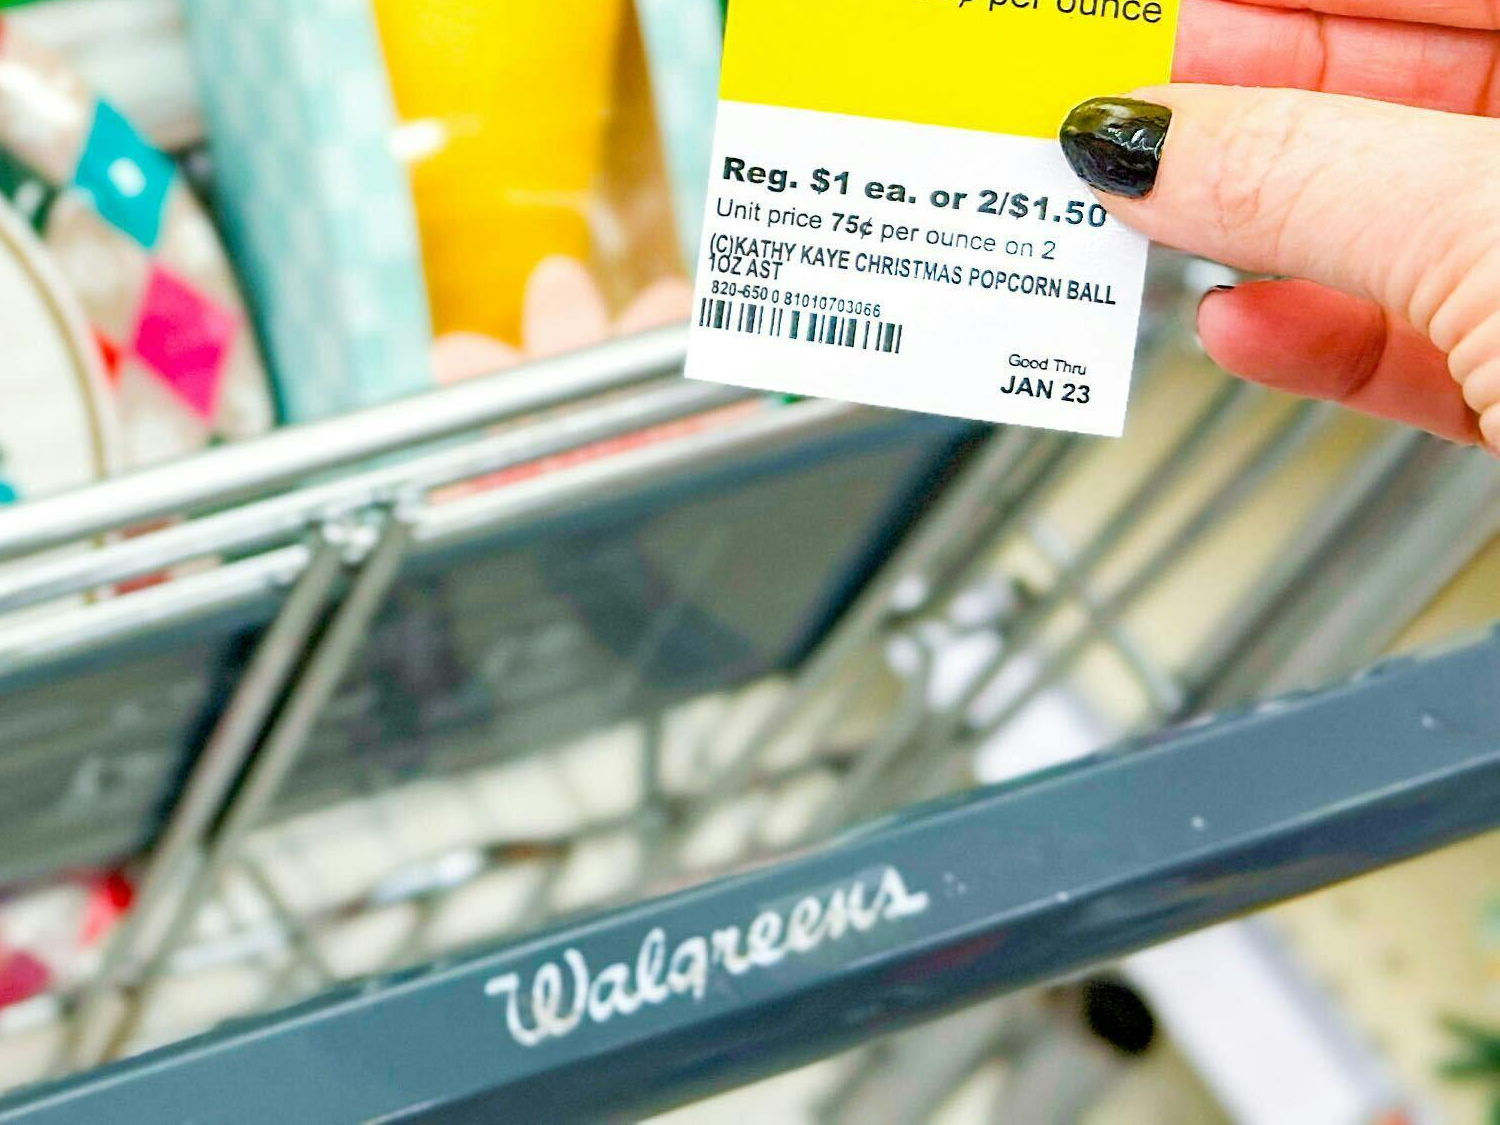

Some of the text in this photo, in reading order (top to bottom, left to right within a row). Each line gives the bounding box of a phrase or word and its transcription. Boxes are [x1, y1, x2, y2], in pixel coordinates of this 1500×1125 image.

[723, 157, 1106, 227] Reg. $1 ea. or 2/$1.50
[717, 198, 1056, 260] Unit price 75¢ per ounce on 2
[710, 232, 1116, 305] (C)KATHY KAYE CHRISTMAS POPCORN BALL
[711, 280, 768, 300] 820-650
[746, 259, 783, 280] AST
[1008, 353, 1087, 375] Good Thru
[1000, 375, 1090, 404] JAN 23
[485, 865, 929, 1047] Walgreens
